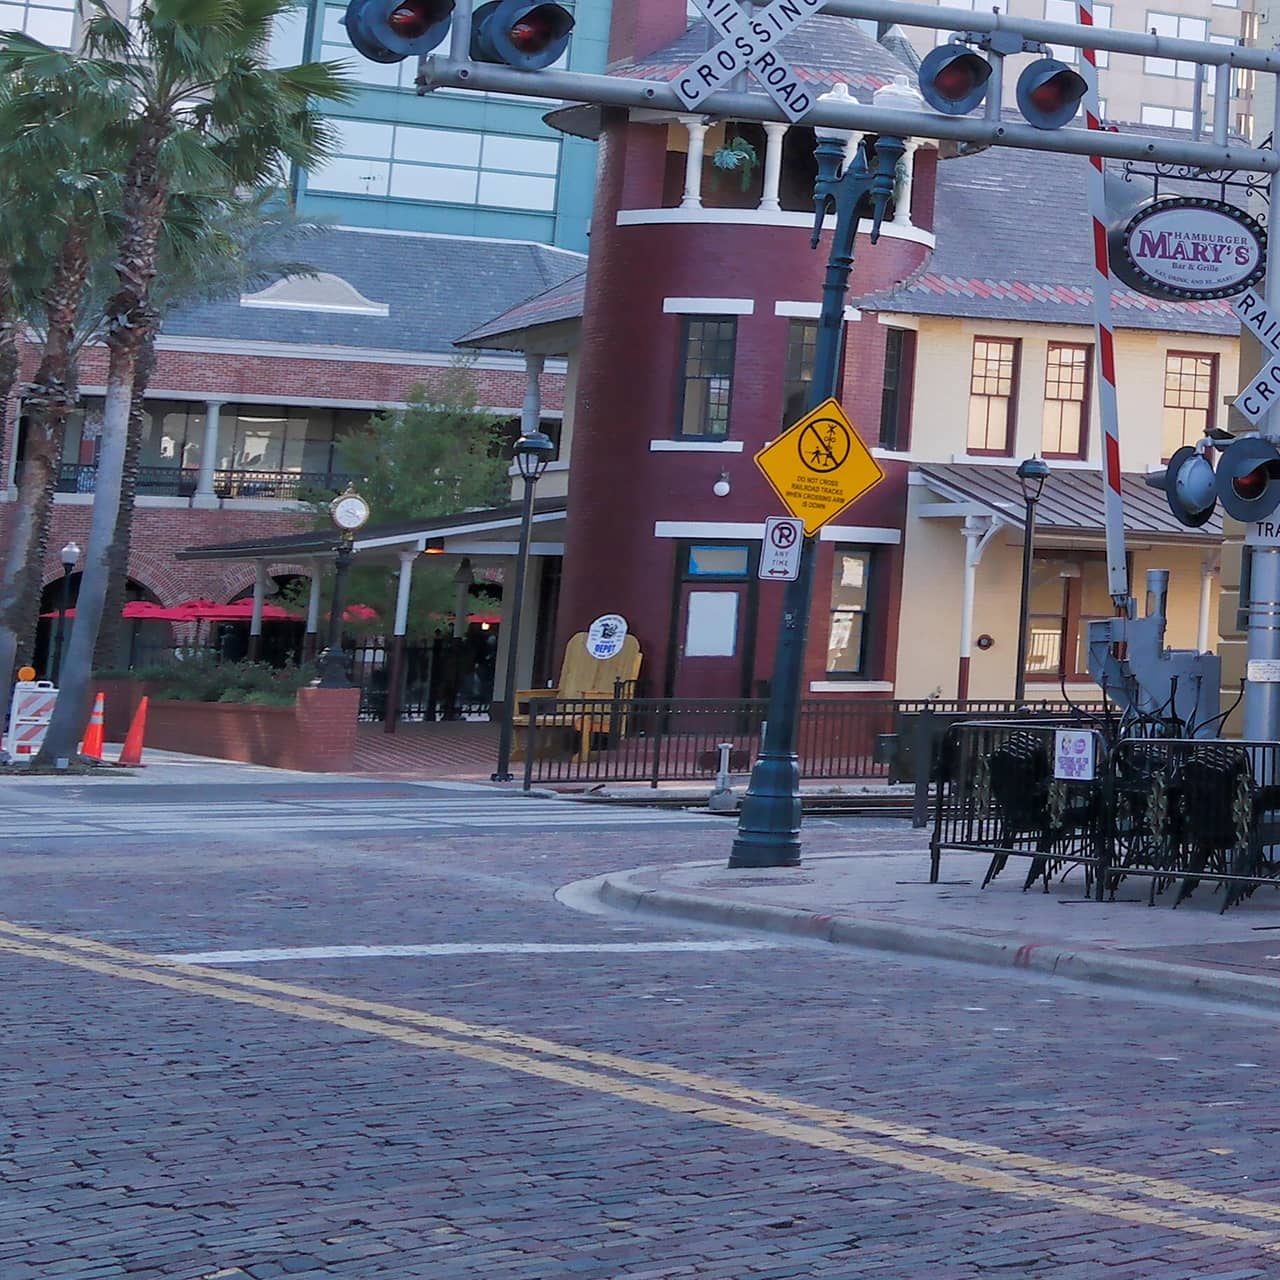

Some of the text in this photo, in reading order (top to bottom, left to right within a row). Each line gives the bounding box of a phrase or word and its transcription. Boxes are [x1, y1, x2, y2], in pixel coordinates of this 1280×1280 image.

[755, 51, 810, 113] ROAD
[1174, 231, 1248, 245] HAMBURGER
[1136, 229, 1250, 266] MARY'S
[1172, 262, 1219, 272] Bar & Grille
[774, 550, 789, 558] ANY
[772, 559, 789, 567] TIME
